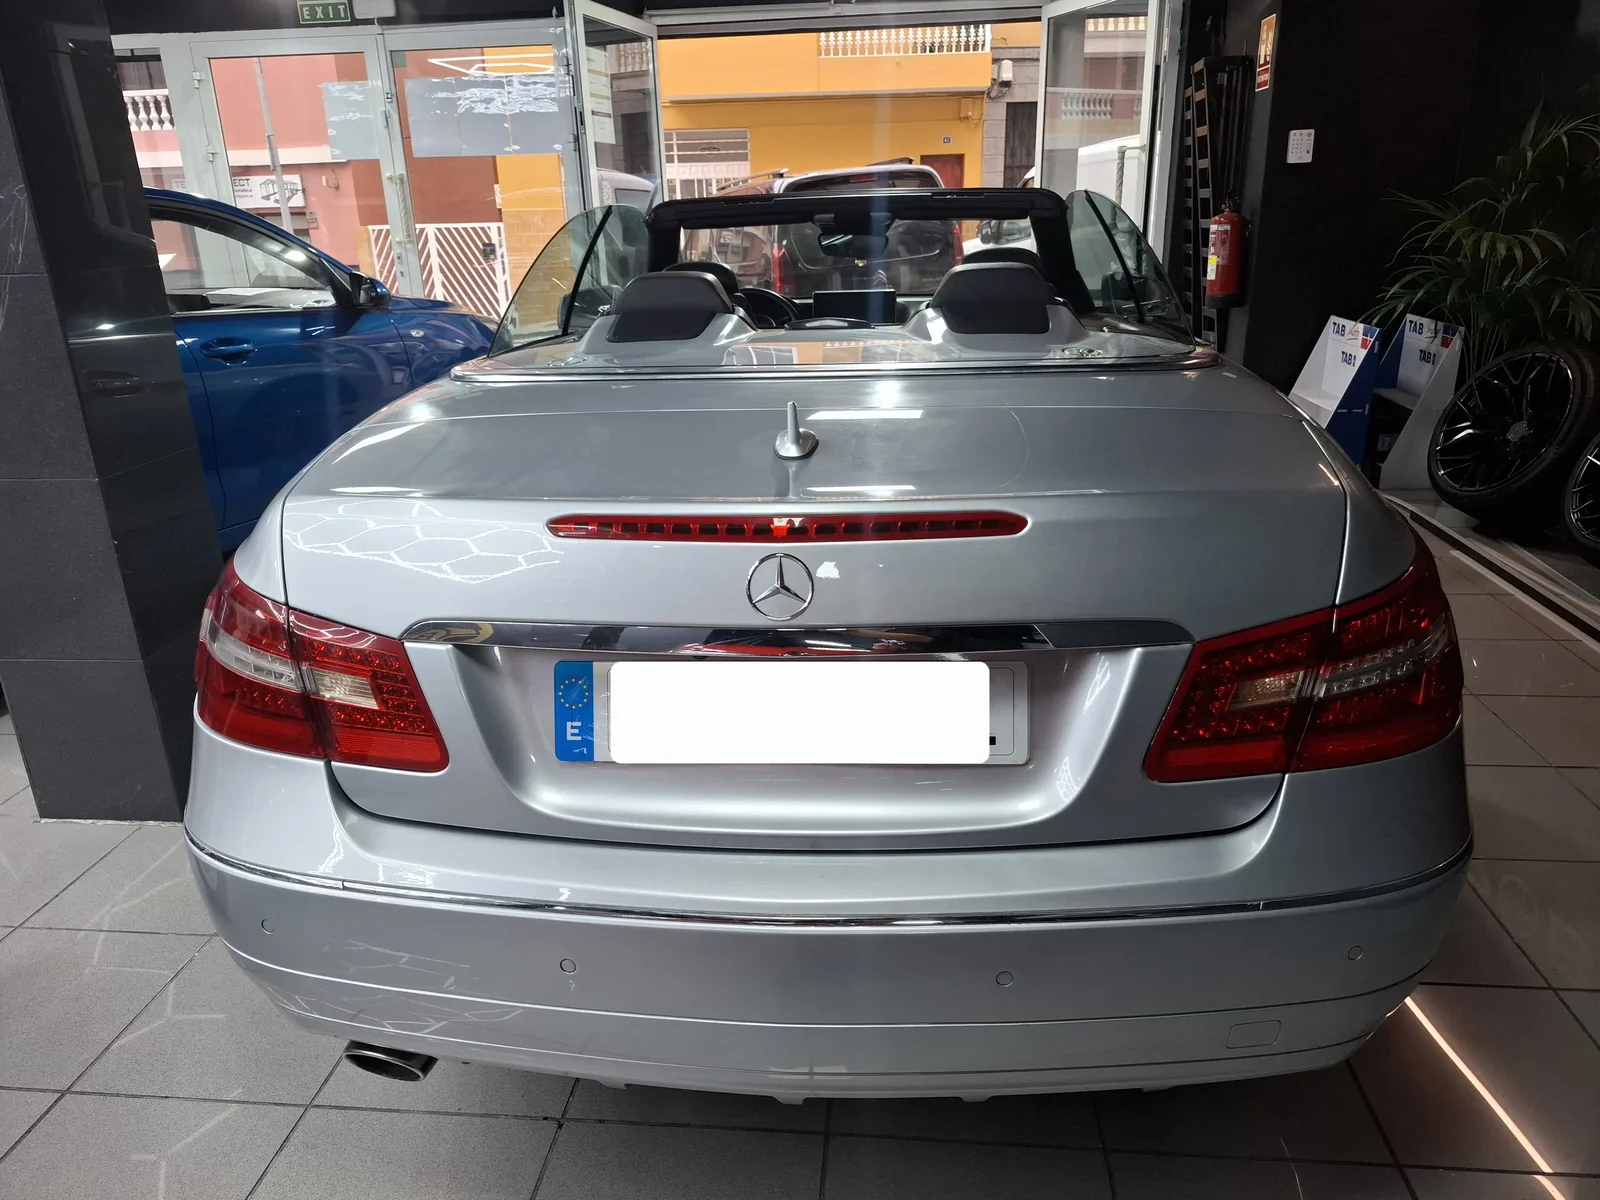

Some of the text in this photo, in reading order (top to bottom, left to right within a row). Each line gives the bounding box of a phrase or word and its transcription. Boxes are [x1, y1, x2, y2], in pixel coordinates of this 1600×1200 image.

[302, 5, 346, 19] EXIT
[1332, 322, 1346, 337] TAB
[1408, 320, 1424, 335] TAB
[1341, 351, 1353, 366] TAB
[1419, 348, 1432, 365] TAB
[566, 721, 582, 741] E
